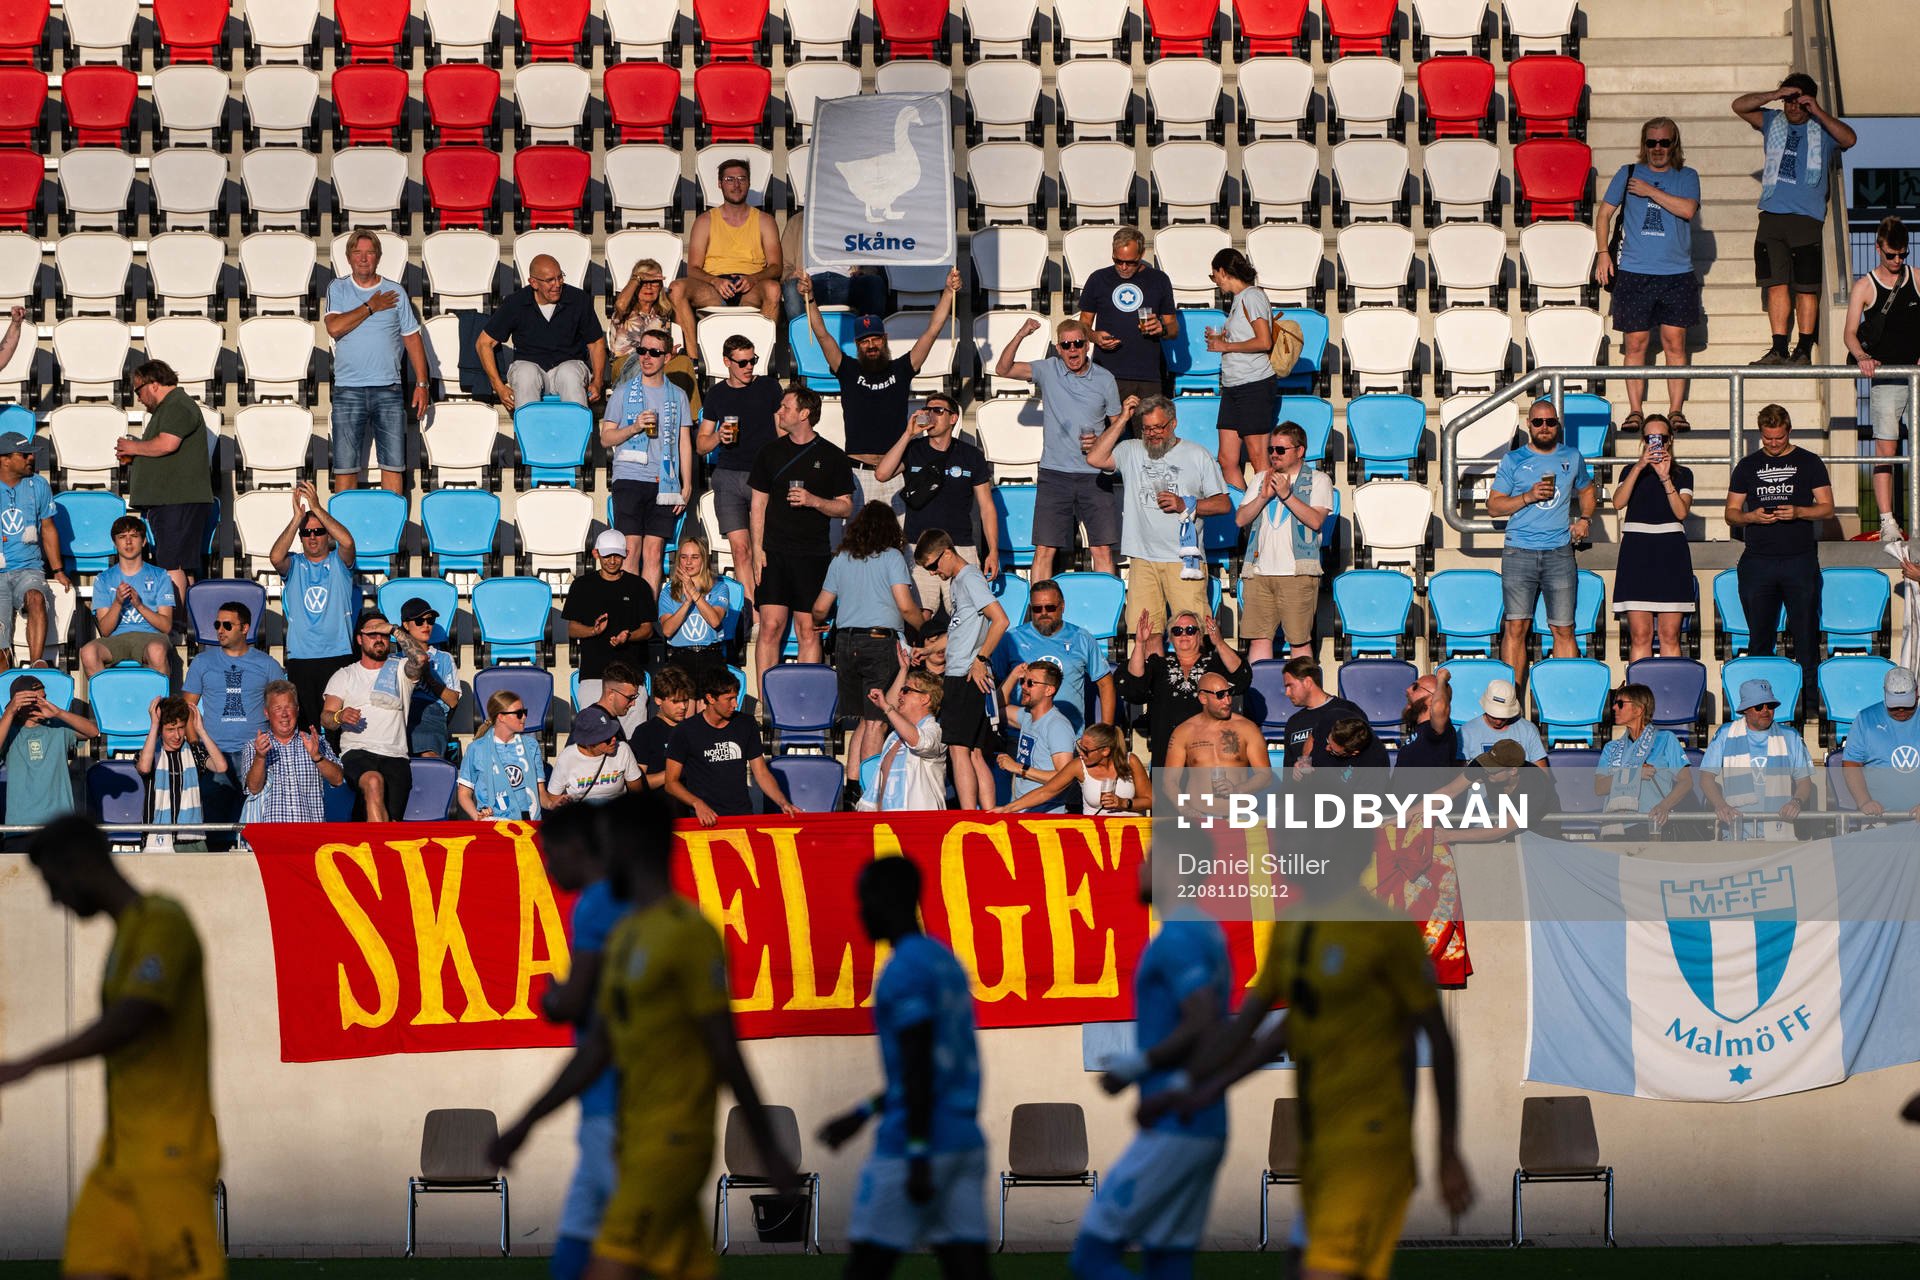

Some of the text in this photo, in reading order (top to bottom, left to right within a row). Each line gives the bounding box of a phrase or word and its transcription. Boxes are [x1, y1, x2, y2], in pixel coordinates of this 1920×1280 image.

[844, 231, 916, 252] Skåne
[1756, 483, 1794, 496] mesta
[304, 586, 328, 613] VW
[682, 614, 707, 641] VW
[704, 749, 729, 757] NORTH
[714, 742, 729, 750] THE
[1890, 745, 1920, 773] VW
[314, 816, 1180, 1031] SKÅELGE
[1665, 1004, 1811, 1057] Malmö FF
